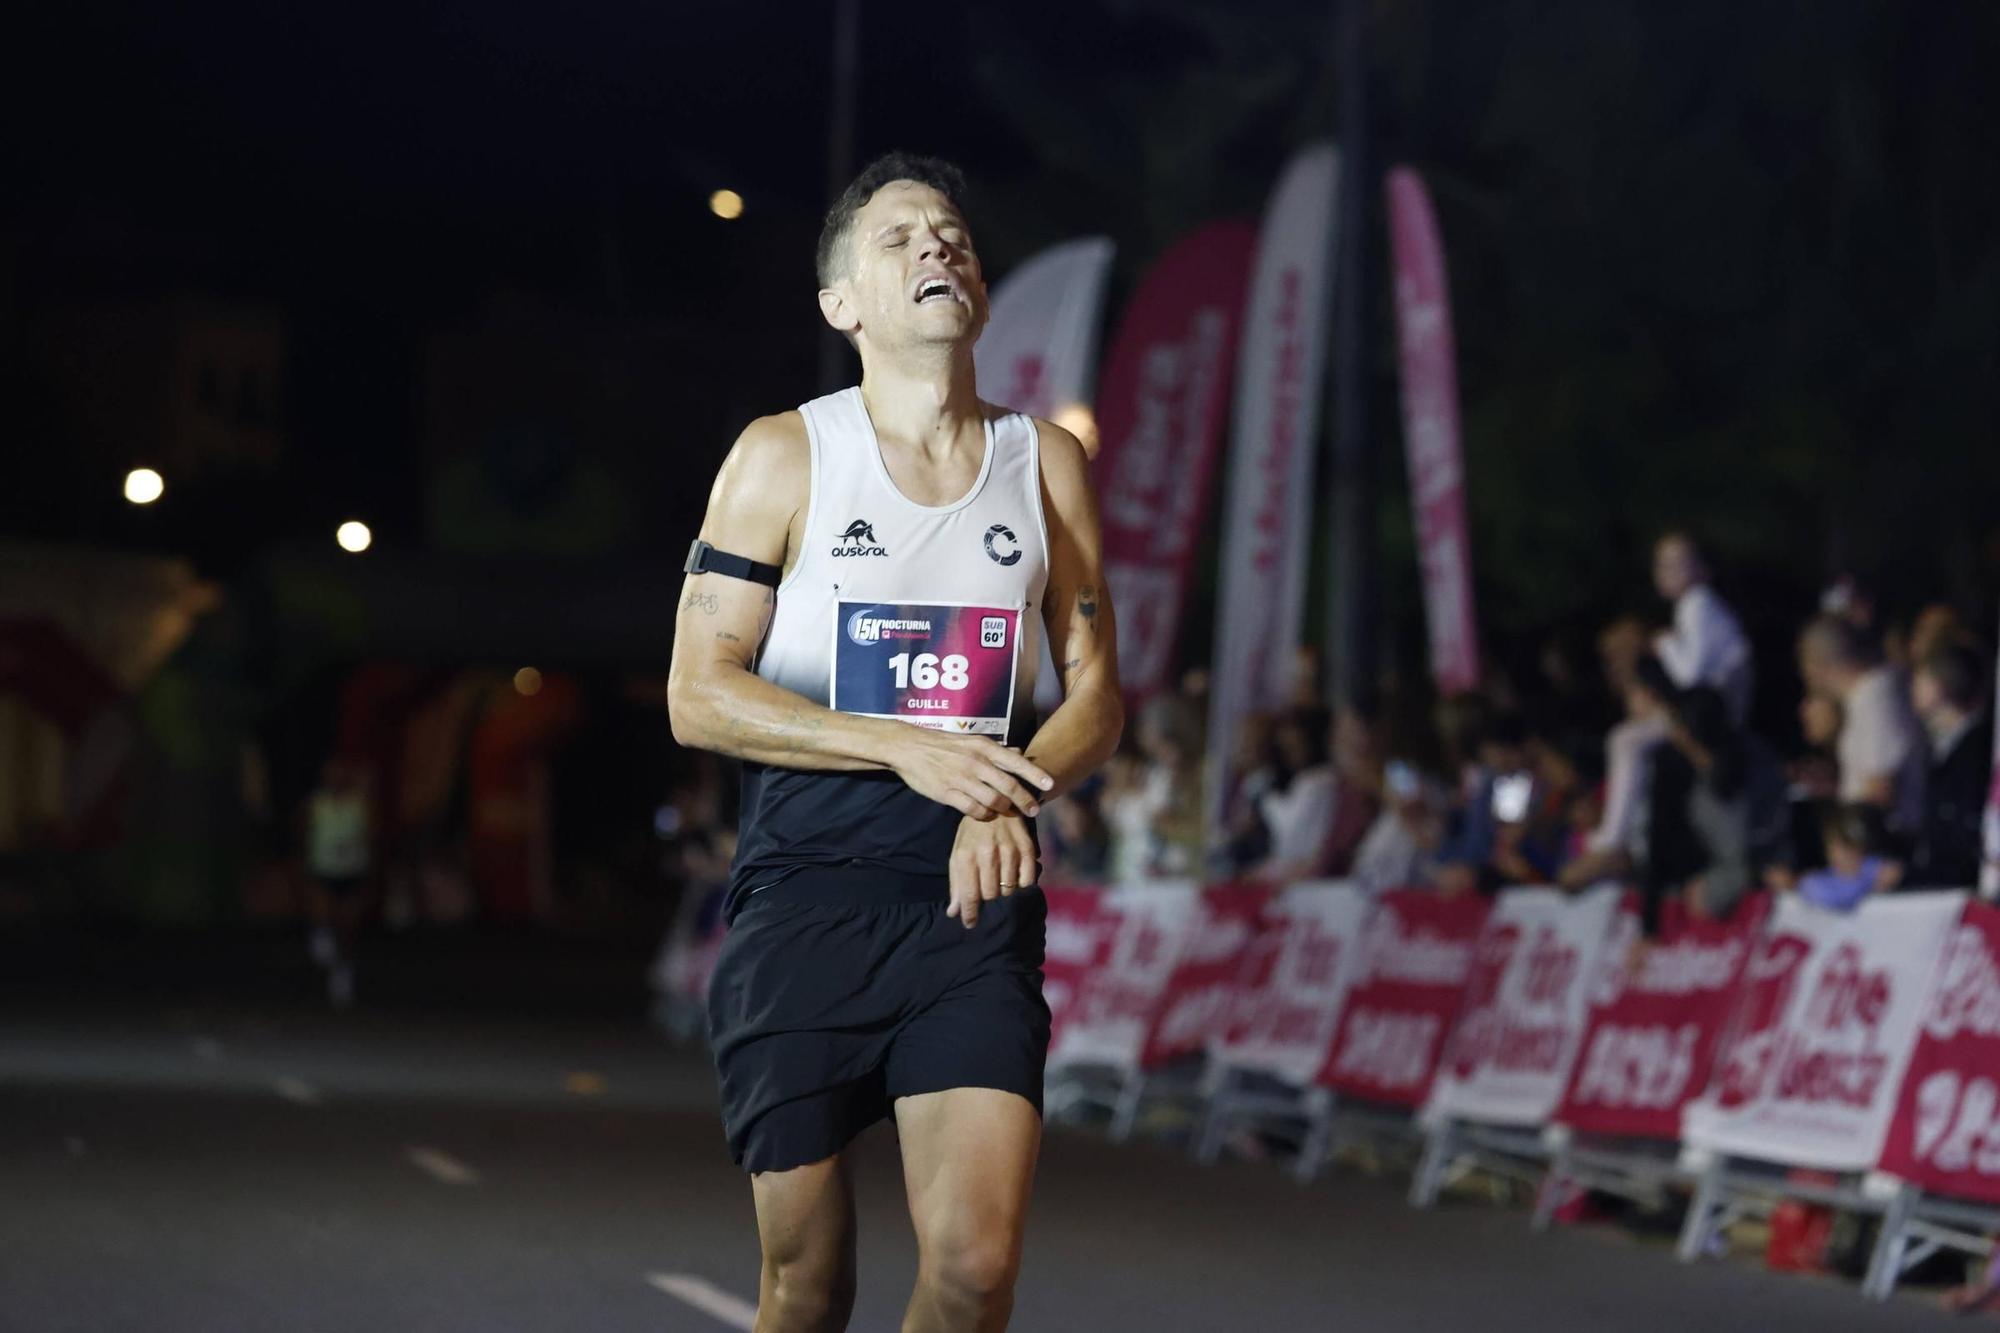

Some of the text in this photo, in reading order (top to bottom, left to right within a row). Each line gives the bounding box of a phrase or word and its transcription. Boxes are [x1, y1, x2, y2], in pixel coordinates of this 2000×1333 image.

[831, 546, 889, 557] austral
[854, 619, 882, 640] 15K
[882, 619, 931, 630] NOCTURNA
[984, 621, 1003, 630] SUB
[888, 653, 969, 690] 168
[907, 699, 950, 709] GUILLE
